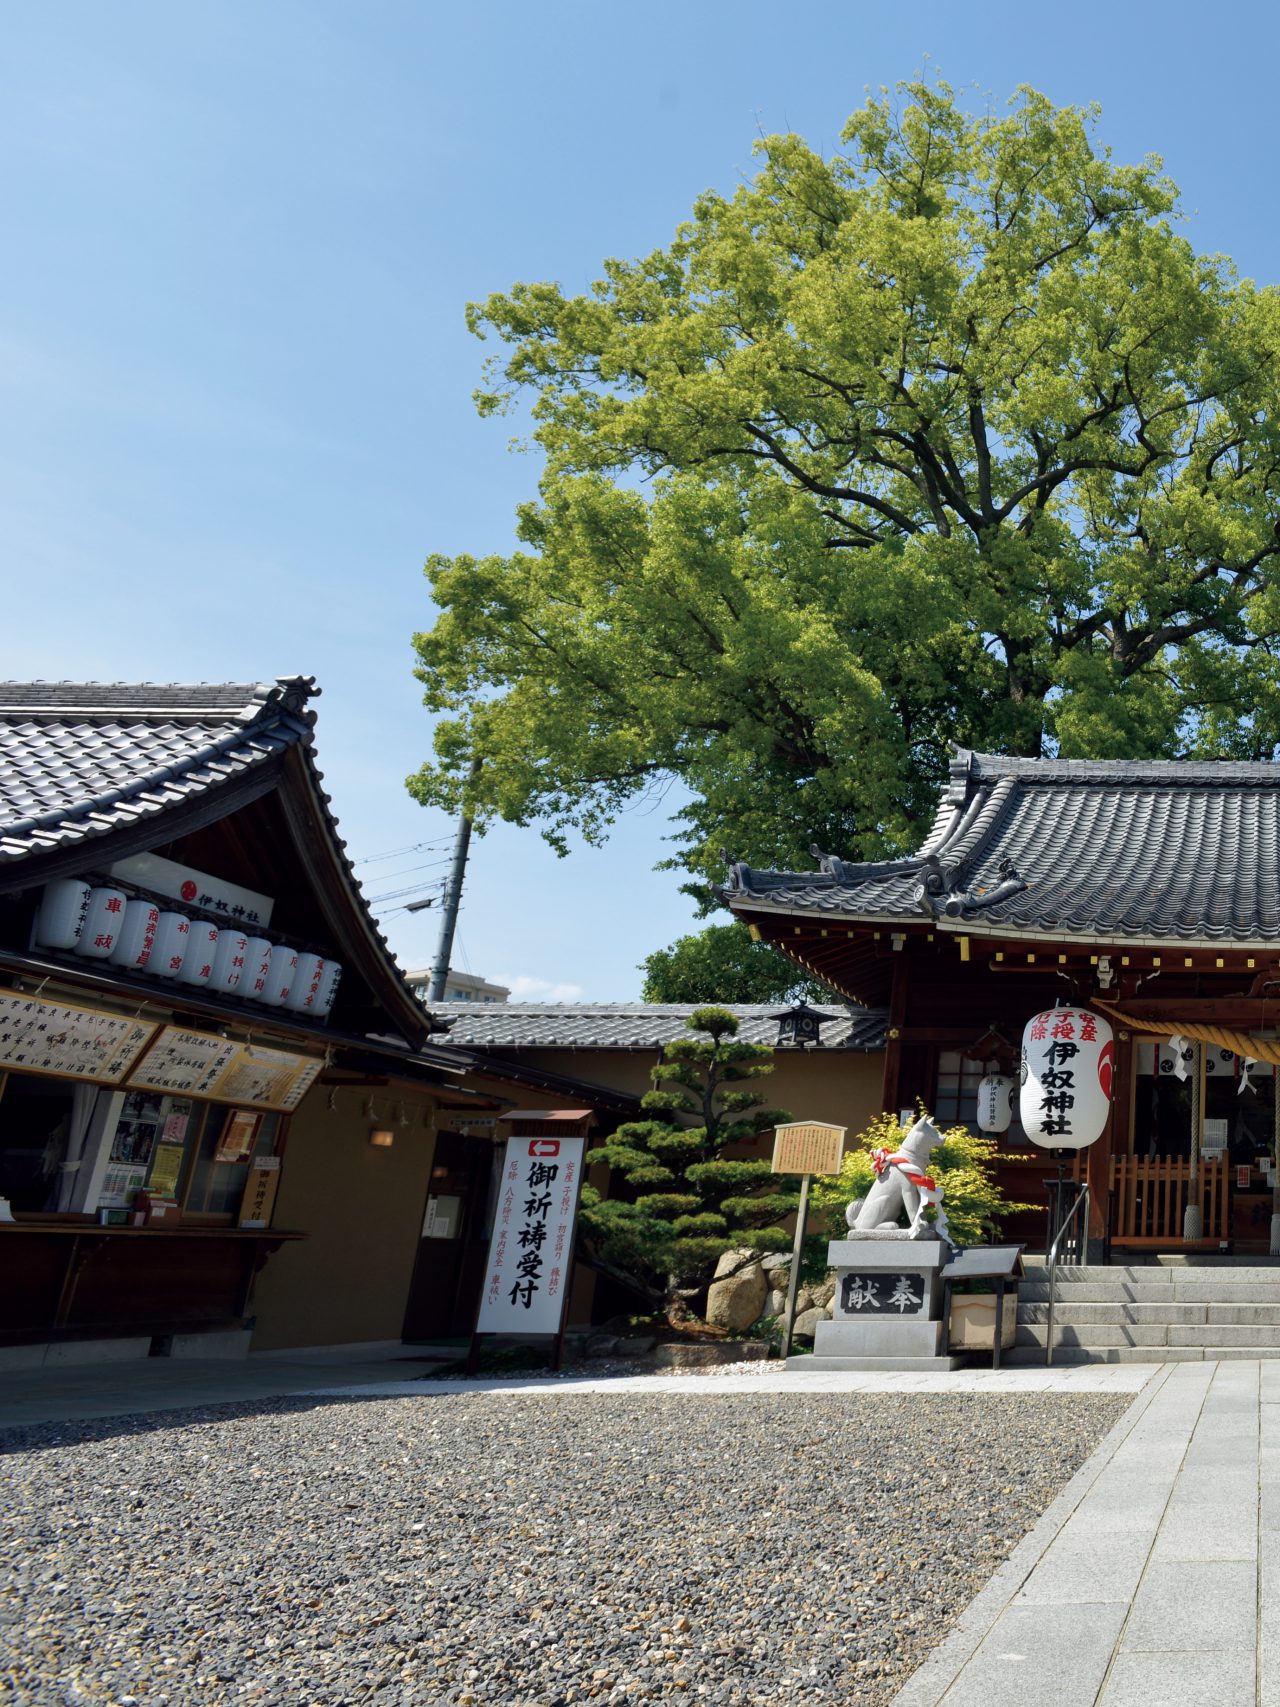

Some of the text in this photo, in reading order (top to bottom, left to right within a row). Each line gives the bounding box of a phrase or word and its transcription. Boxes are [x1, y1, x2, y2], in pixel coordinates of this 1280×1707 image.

[197, 894, 260, 924] 伊奴神社
[169, 921, 190, 970] 初宮
[199, 930, 218, 978] 安産
[227, 938, 248, 986] 子授け
[1031, 1012, 1052, 1041] 厄除
[1051, 1011, 1075, 1040] 子授
[1078, 1013, 1098, 1042] 安産
[1039, 1040, 1080, 1136] 伊奴神社
[508, 1161, 559, 1309] 御祈祷受付
